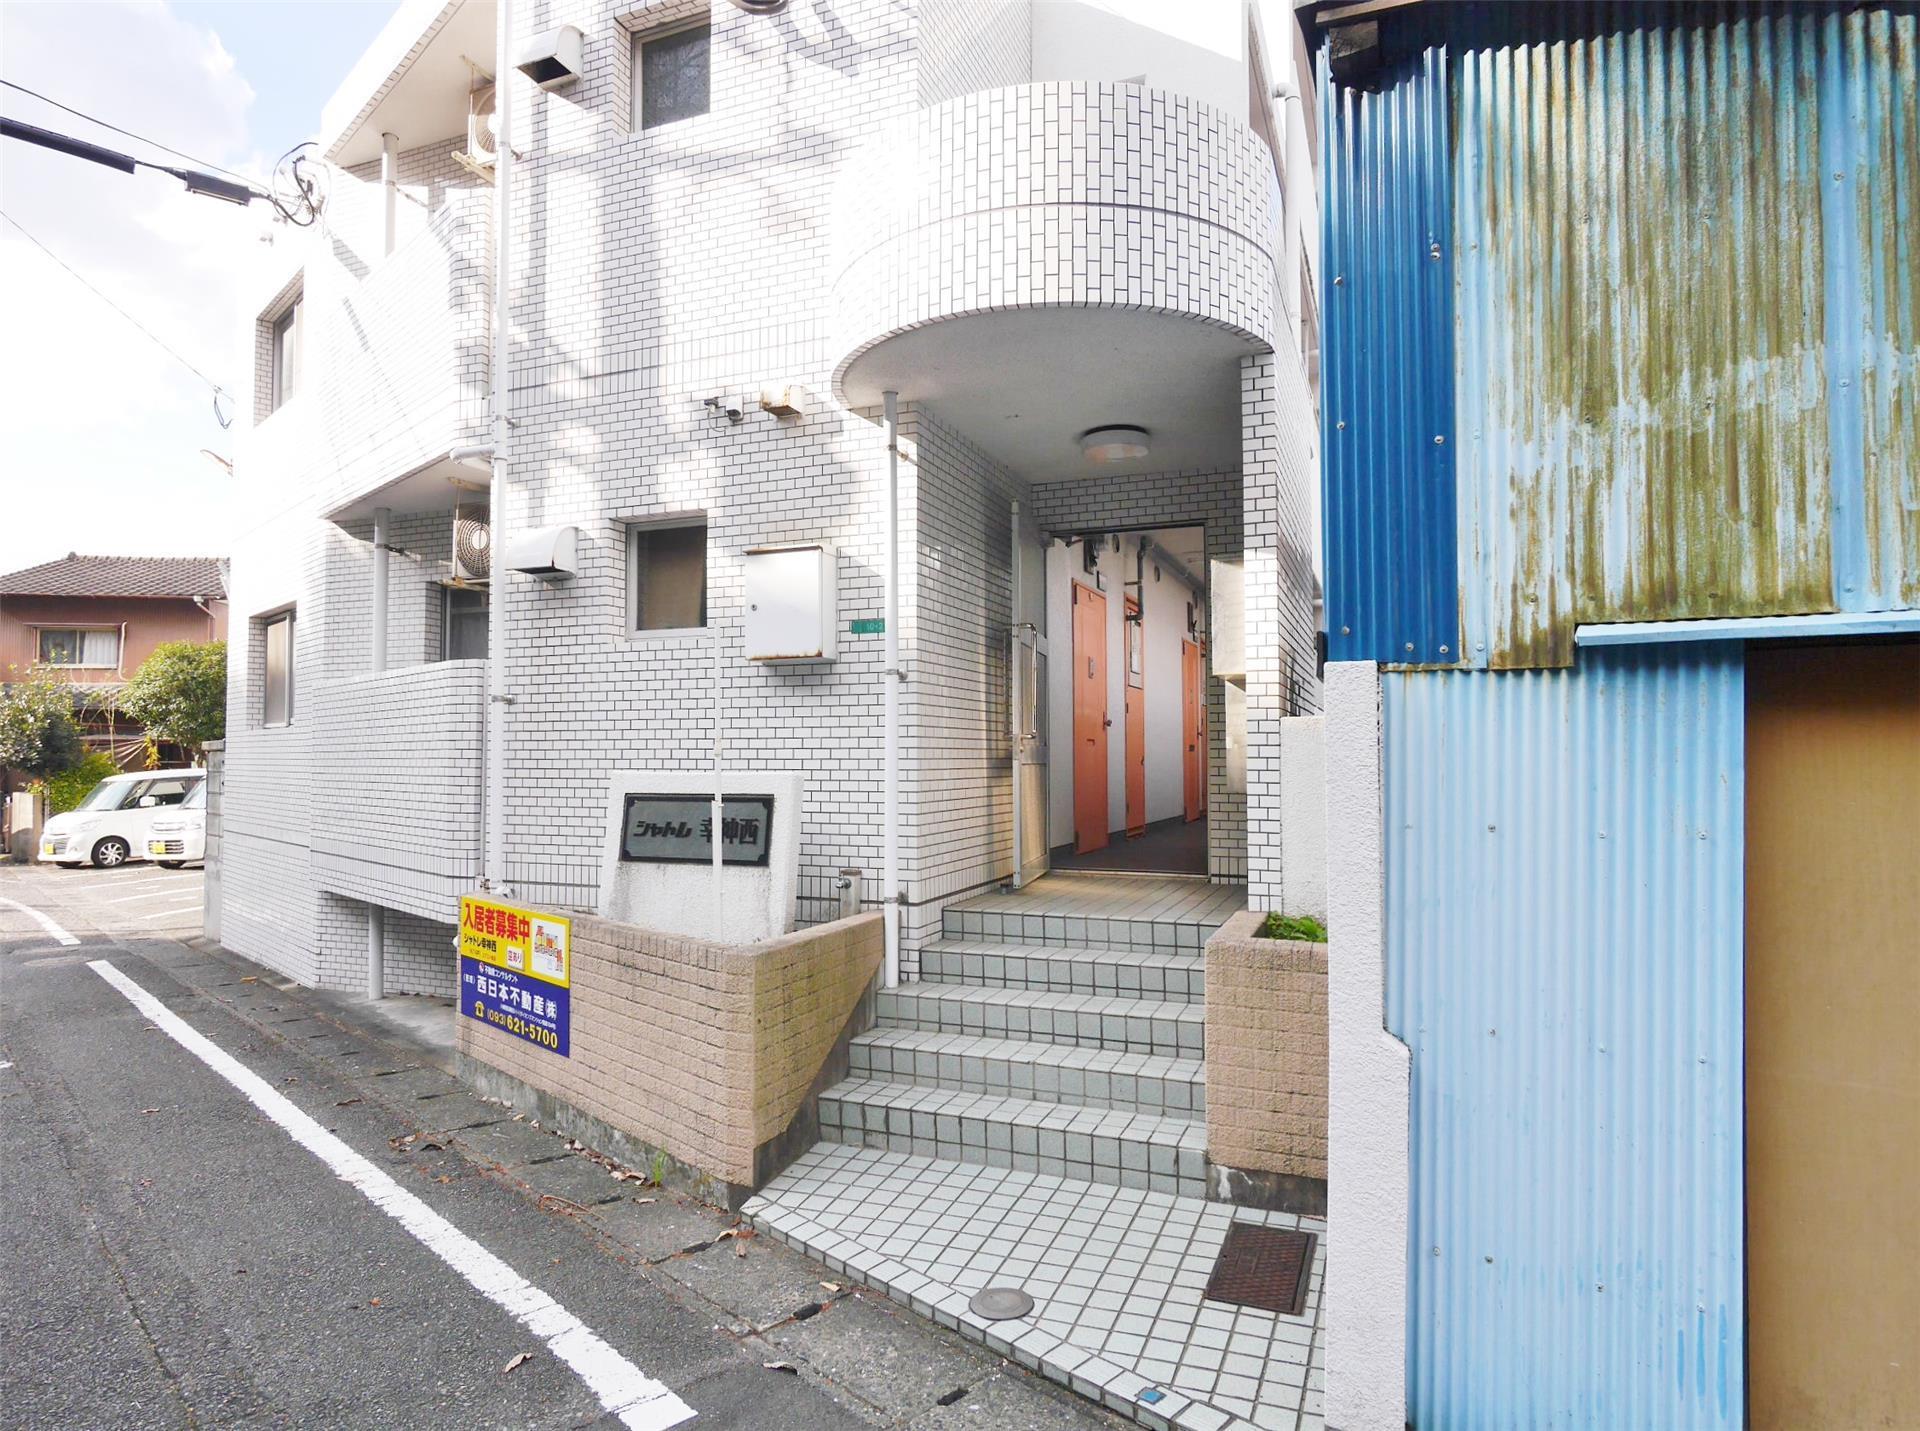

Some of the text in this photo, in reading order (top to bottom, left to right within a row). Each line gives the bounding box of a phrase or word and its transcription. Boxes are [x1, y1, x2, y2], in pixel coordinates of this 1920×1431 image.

[633, 820, 692, 838] シャトレ
[464, 902, 530, 944] 入居者募集中
